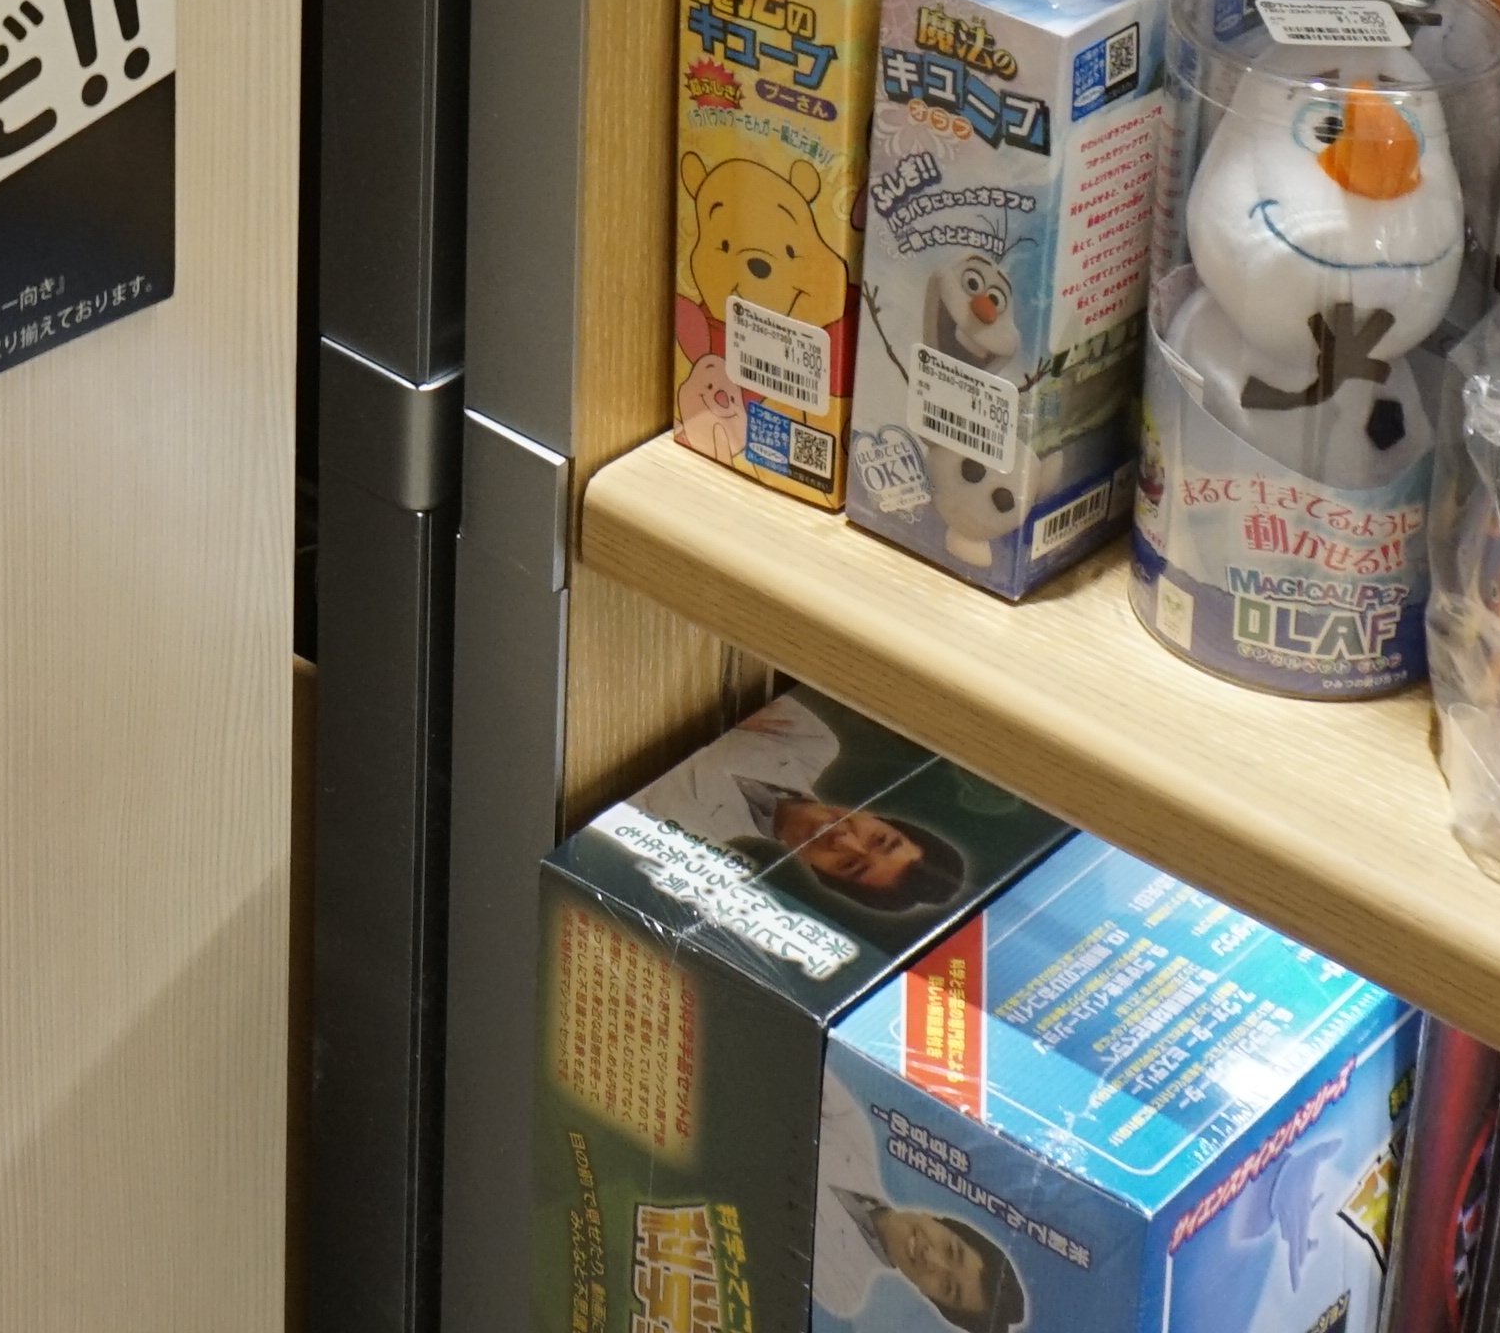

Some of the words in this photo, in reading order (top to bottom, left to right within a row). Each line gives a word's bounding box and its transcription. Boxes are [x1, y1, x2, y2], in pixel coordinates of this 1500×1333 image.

[687, 6, 836, 90] キューブ
[916, 6, 1019, 81] 魔法の
[763, 82, 830, 119] プーさん
[882, 46, 1051, 156] キューブ
[908, 98, 974, 140] オラフ
[1228, 567, 1357, 607] MAGICAL
[1233, 594, 1400, 661] OLAF
